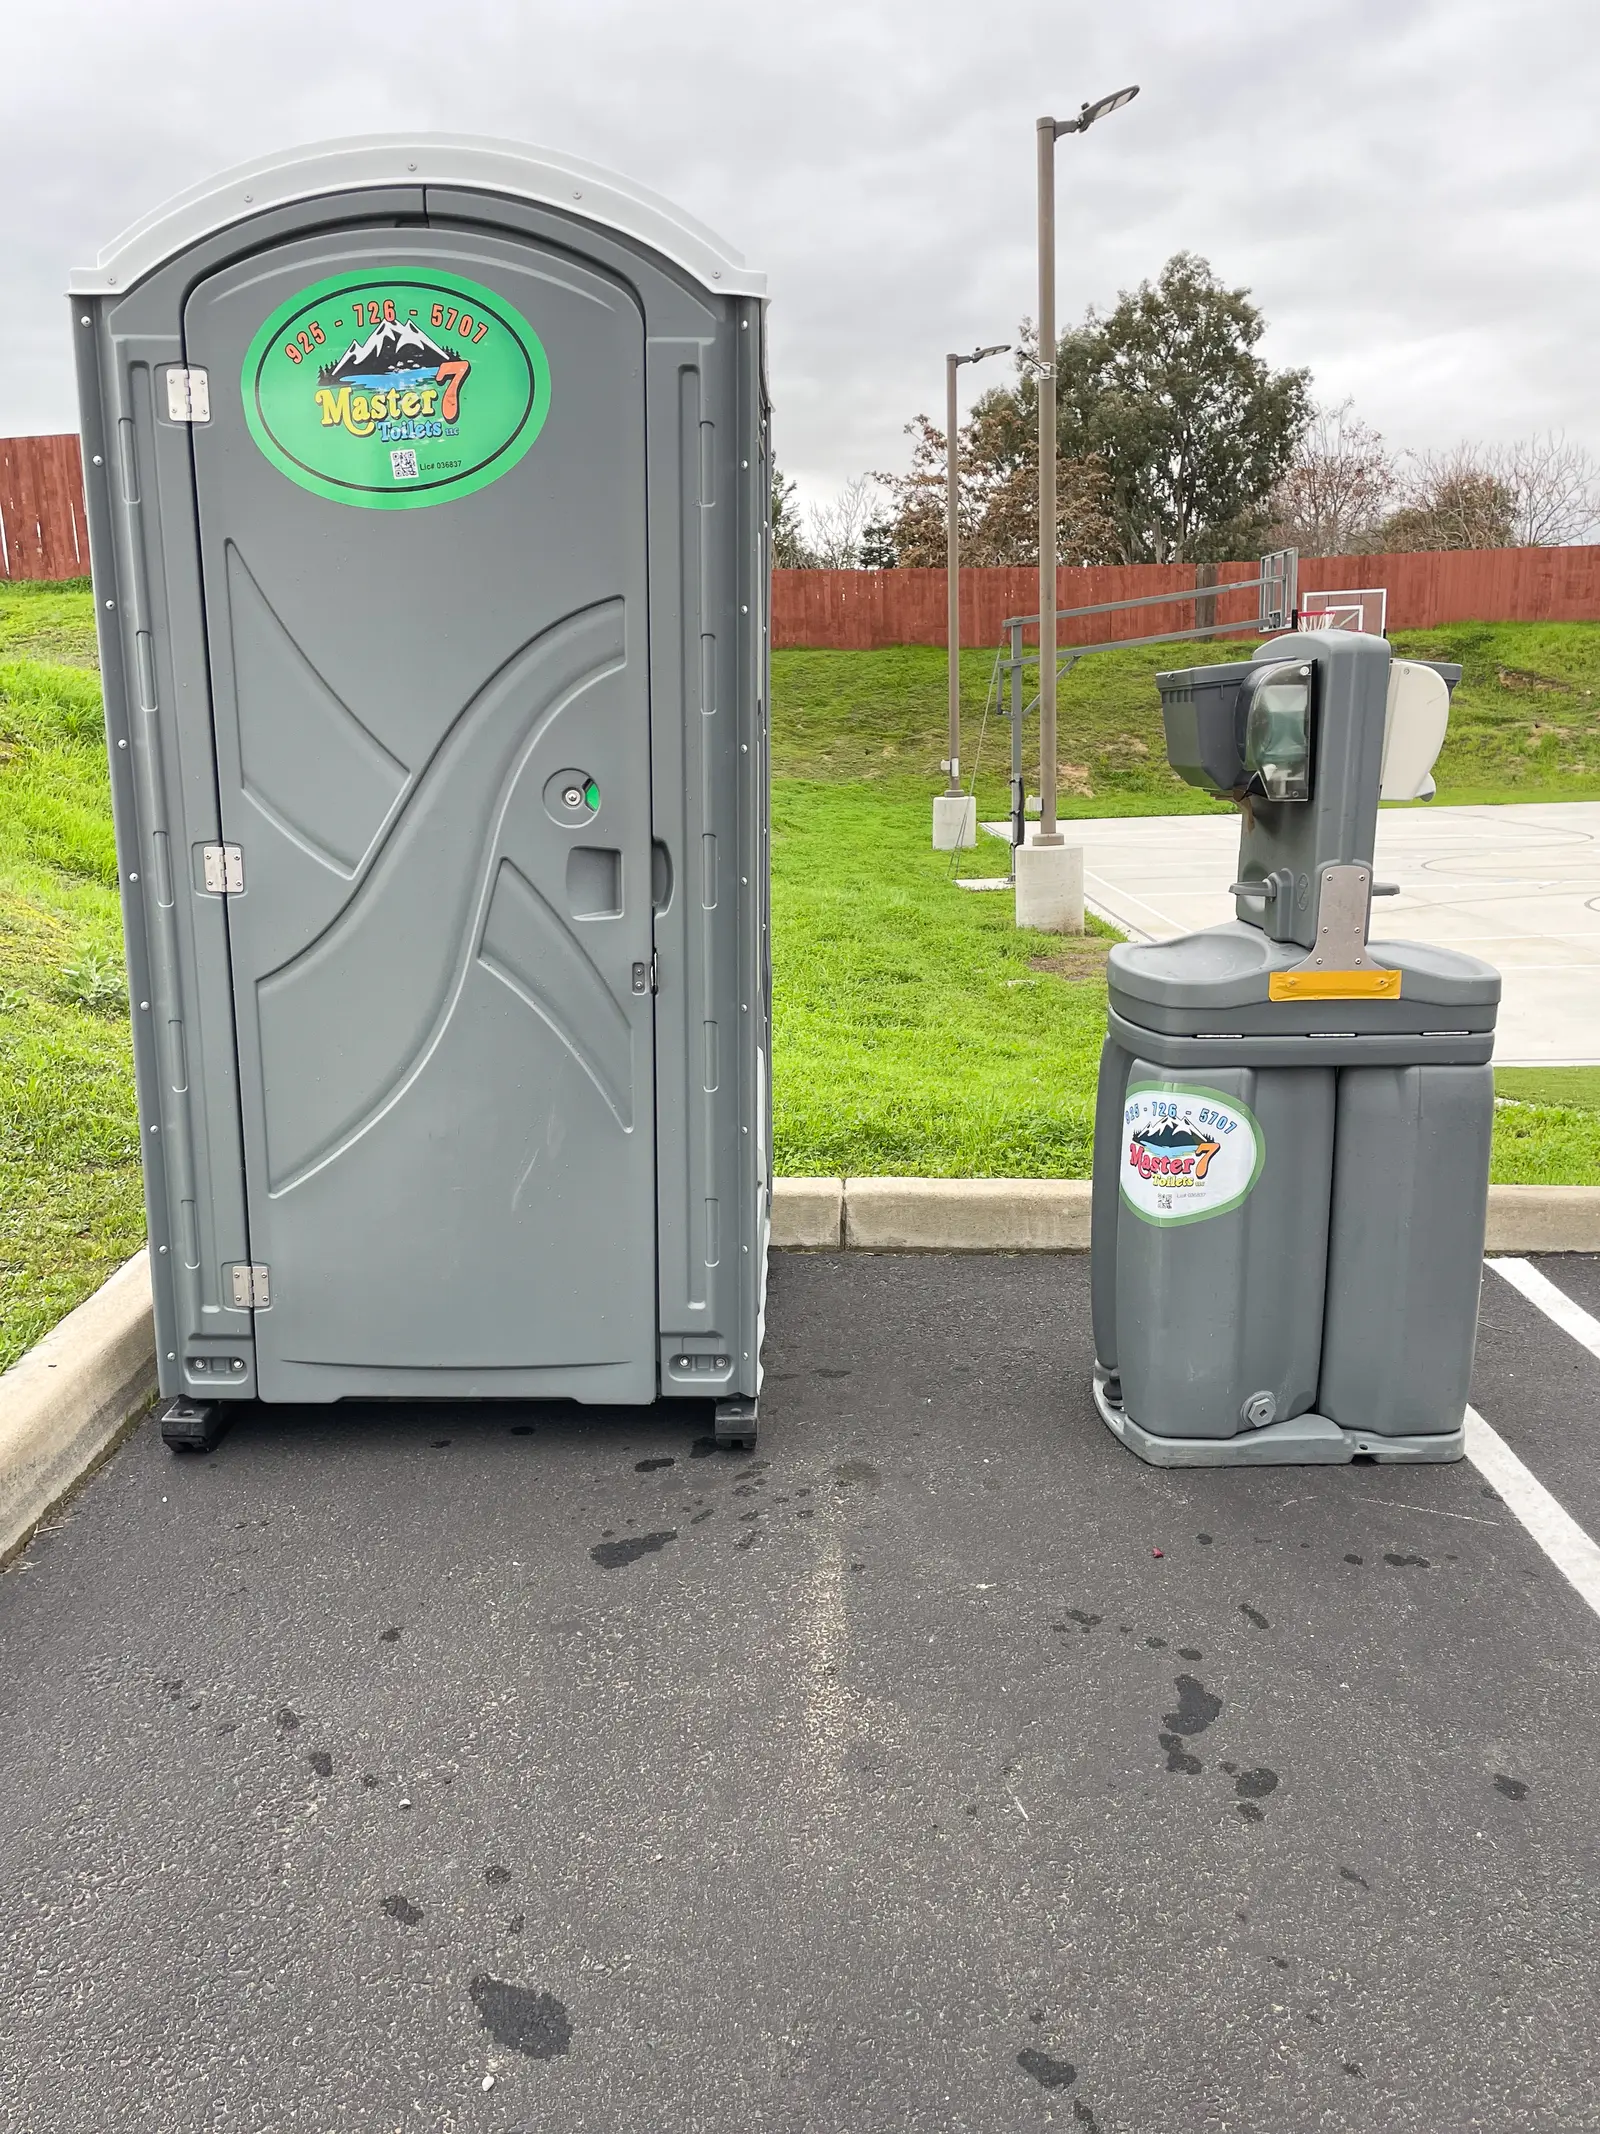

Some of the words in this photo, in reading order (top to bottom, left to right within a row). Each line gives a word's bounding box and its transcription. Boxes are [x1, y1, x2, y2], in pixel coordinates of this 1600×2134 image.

[285, 321, 326, 364] 925
[352, 299, 396, 327] 726
[431, 304, 489, 344] 5707
[315, 387, 438, 436] Master
[436, 360, 471, 423] 7
[377, 419, 442, 443] Toilets
[436, 460, 462, 470] 036837
[1152, 1102, 1177, 1117] 726
[1199, 1108, 1237, 1135] 5707
[1129, 1143, 1195, 1179] Master
[1195, 1142, 1221, 1179] 7
[1152, 1175, 1194, 1187] Toilets
